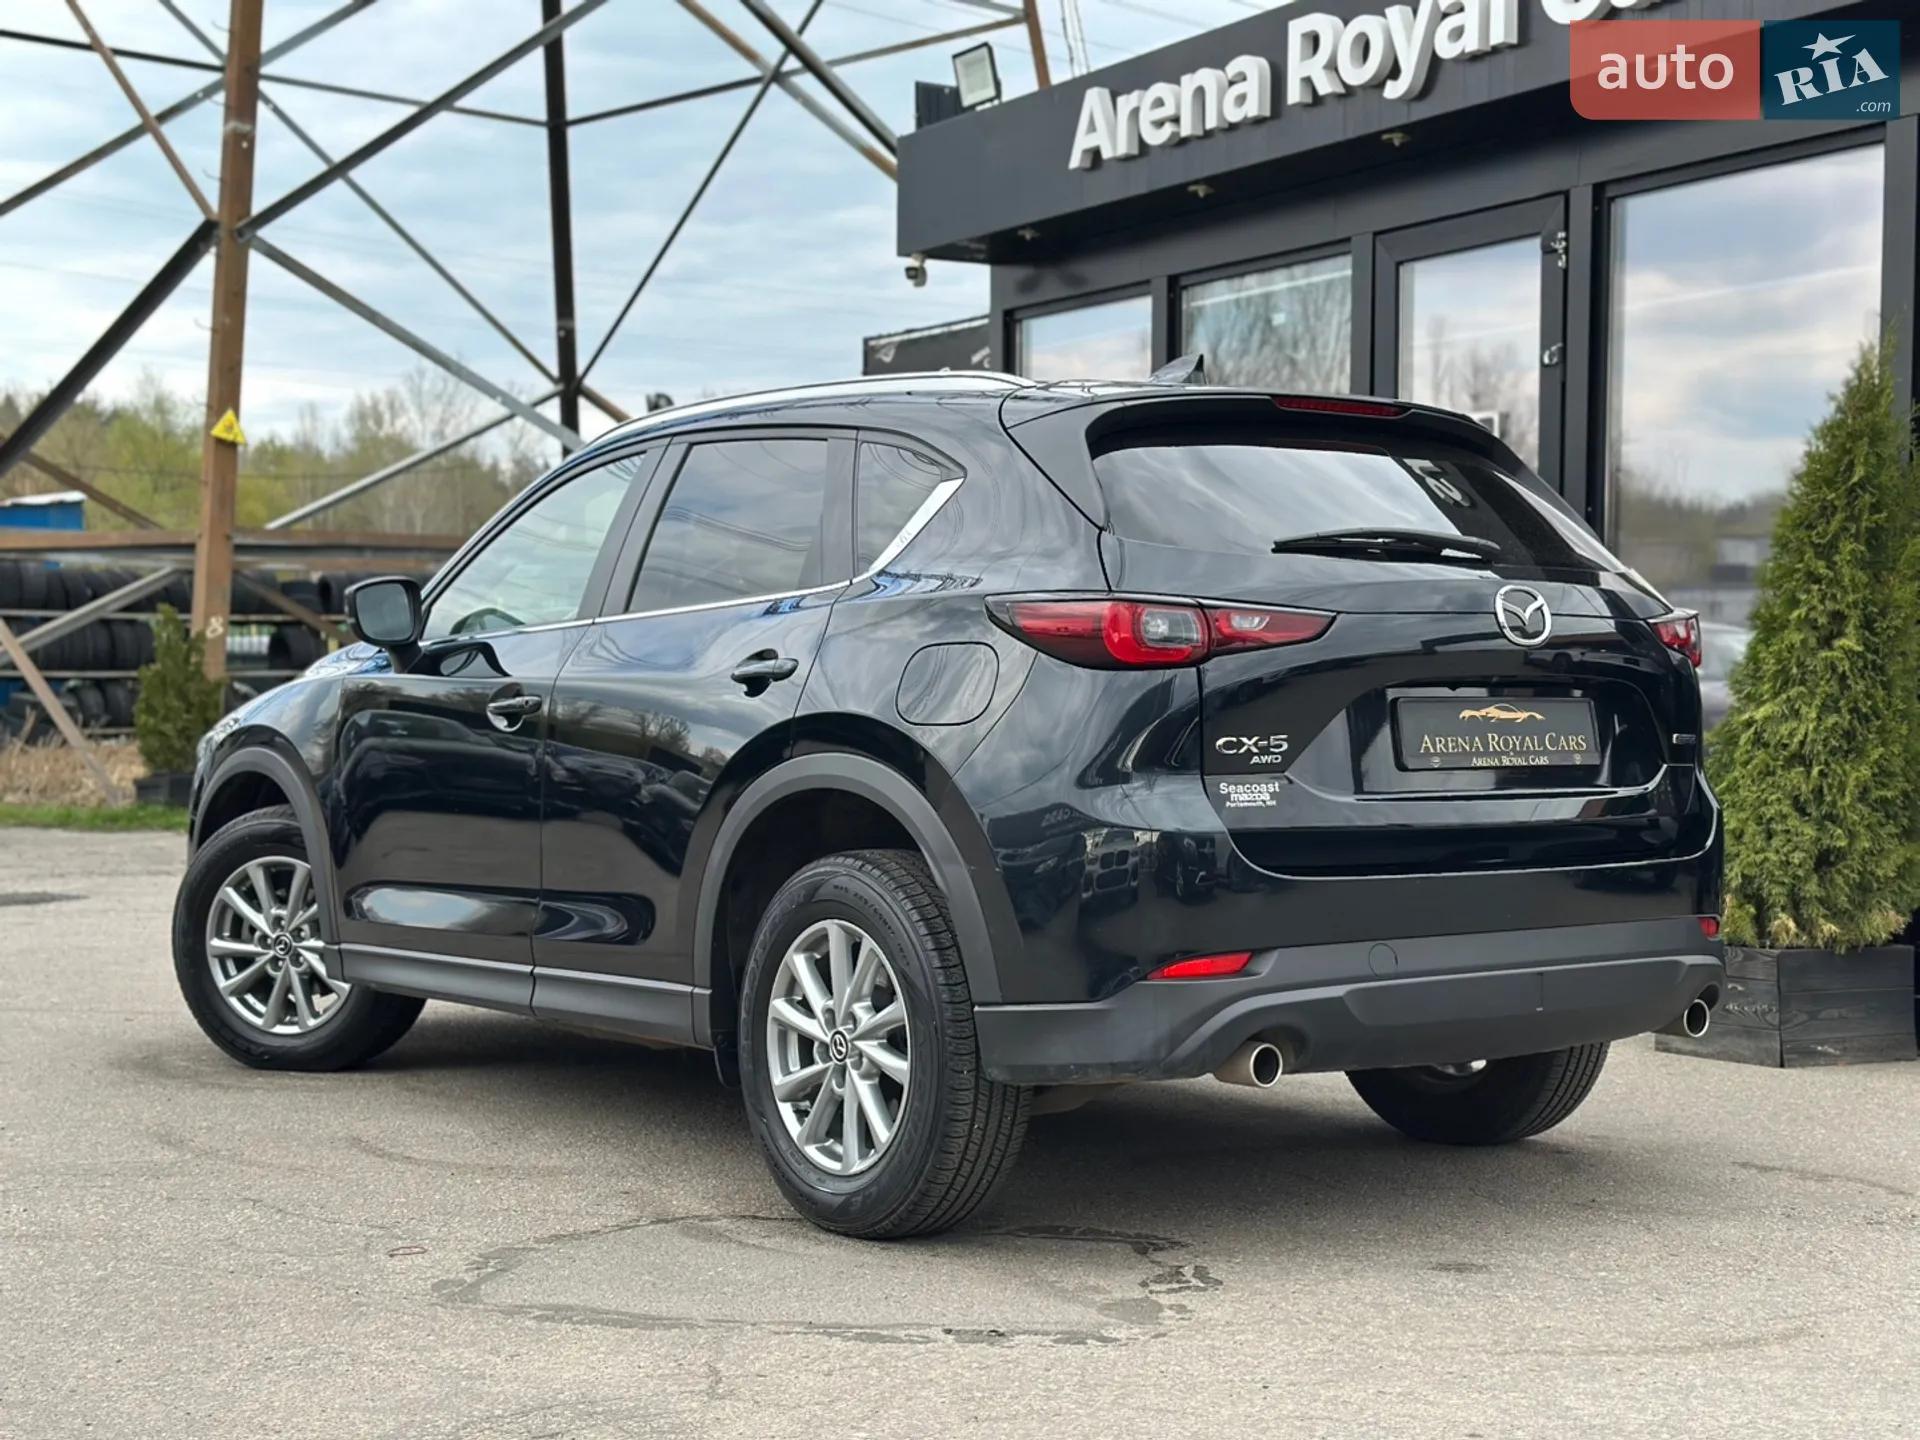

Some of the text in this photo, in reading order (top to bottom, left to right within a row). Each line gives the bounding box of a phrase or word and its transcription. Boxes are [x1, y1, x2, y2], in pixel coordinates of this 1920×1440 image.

[1068, 0, 1518, 170] Arena Royal
[1215, 734, 1288, 754] CX-5
[1420, 732, 1587, 753] ARENA ROYAL CARS
[1249, 754, 1282, 764] AWD
[1471, 754, 1549, 767] ARENA ROYAL CARS
[1219, 781, 1280, 794] Seacoast
